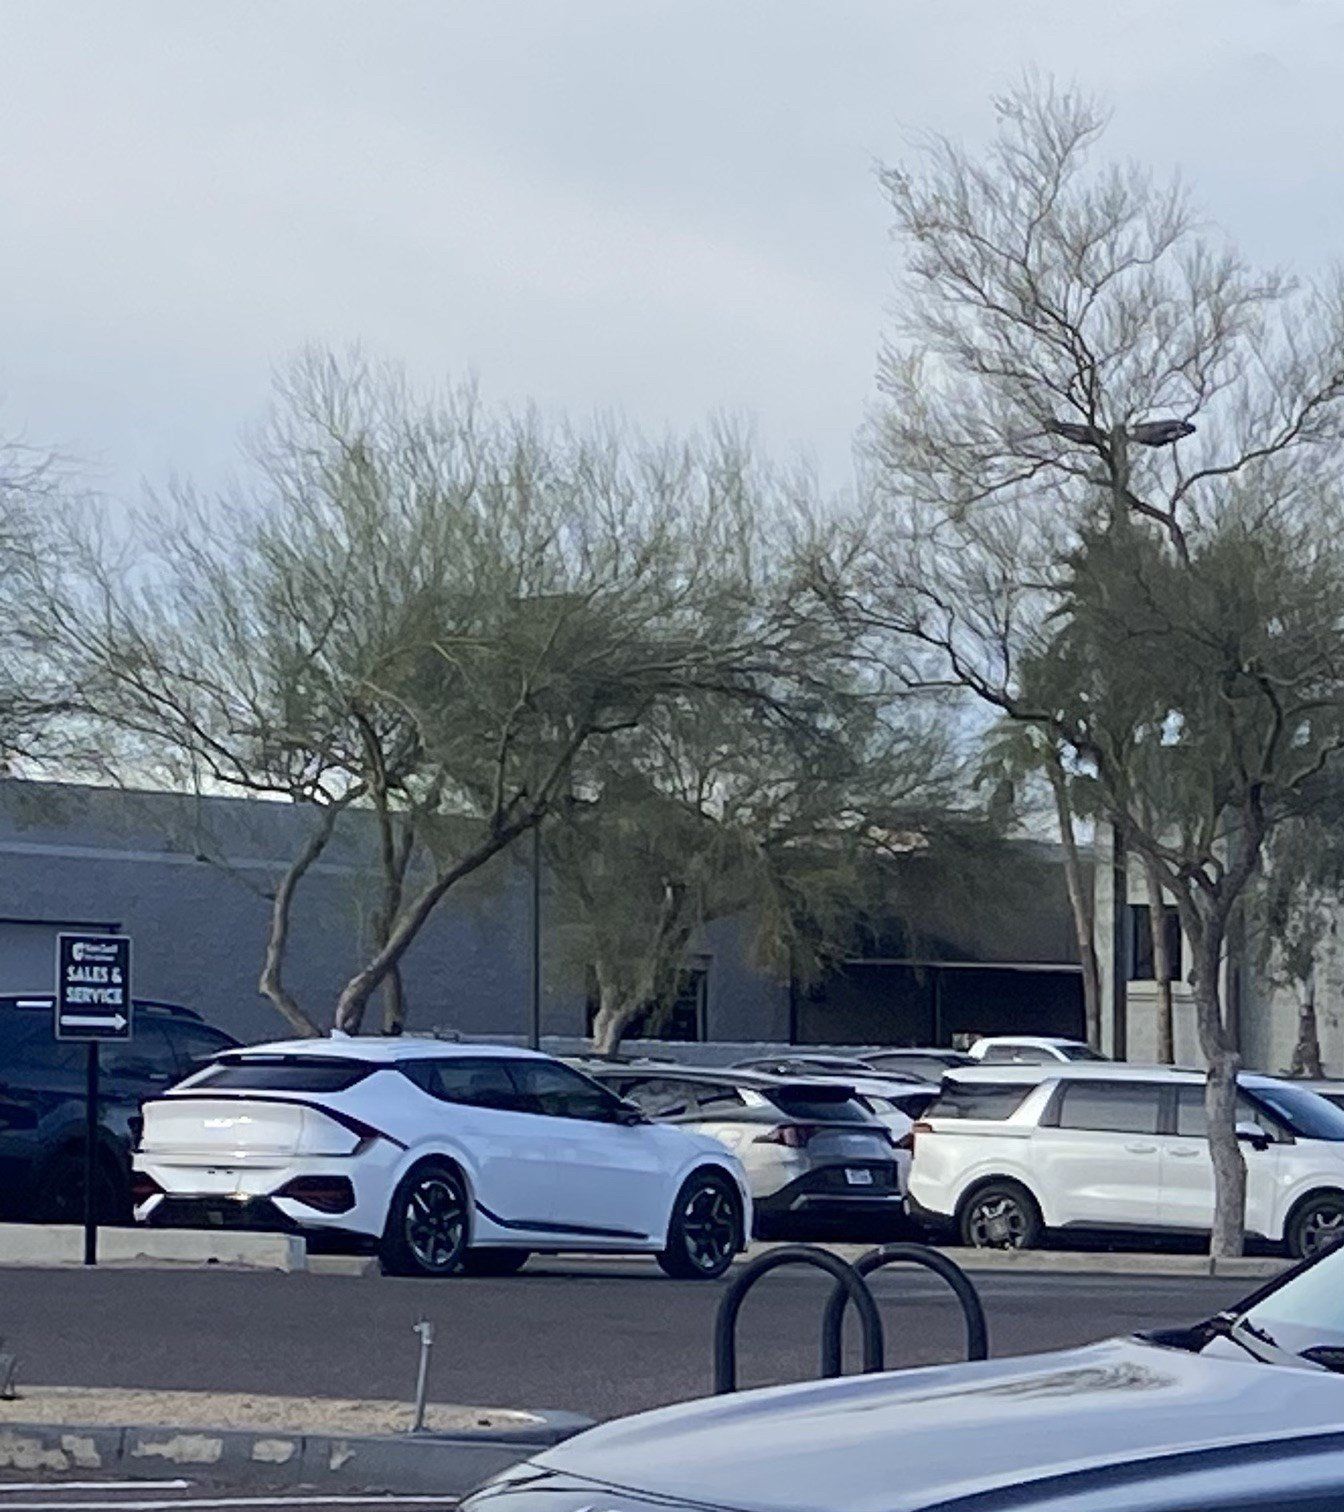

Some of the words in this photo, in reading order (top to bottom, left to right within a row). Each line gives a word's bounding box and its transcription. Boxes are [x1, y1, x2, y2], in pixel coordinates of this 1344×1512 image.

[67, 965, 108, 982] SALES
[111, 966, 122, 984] &
[66, 986, 122, 1004] SERVICE
